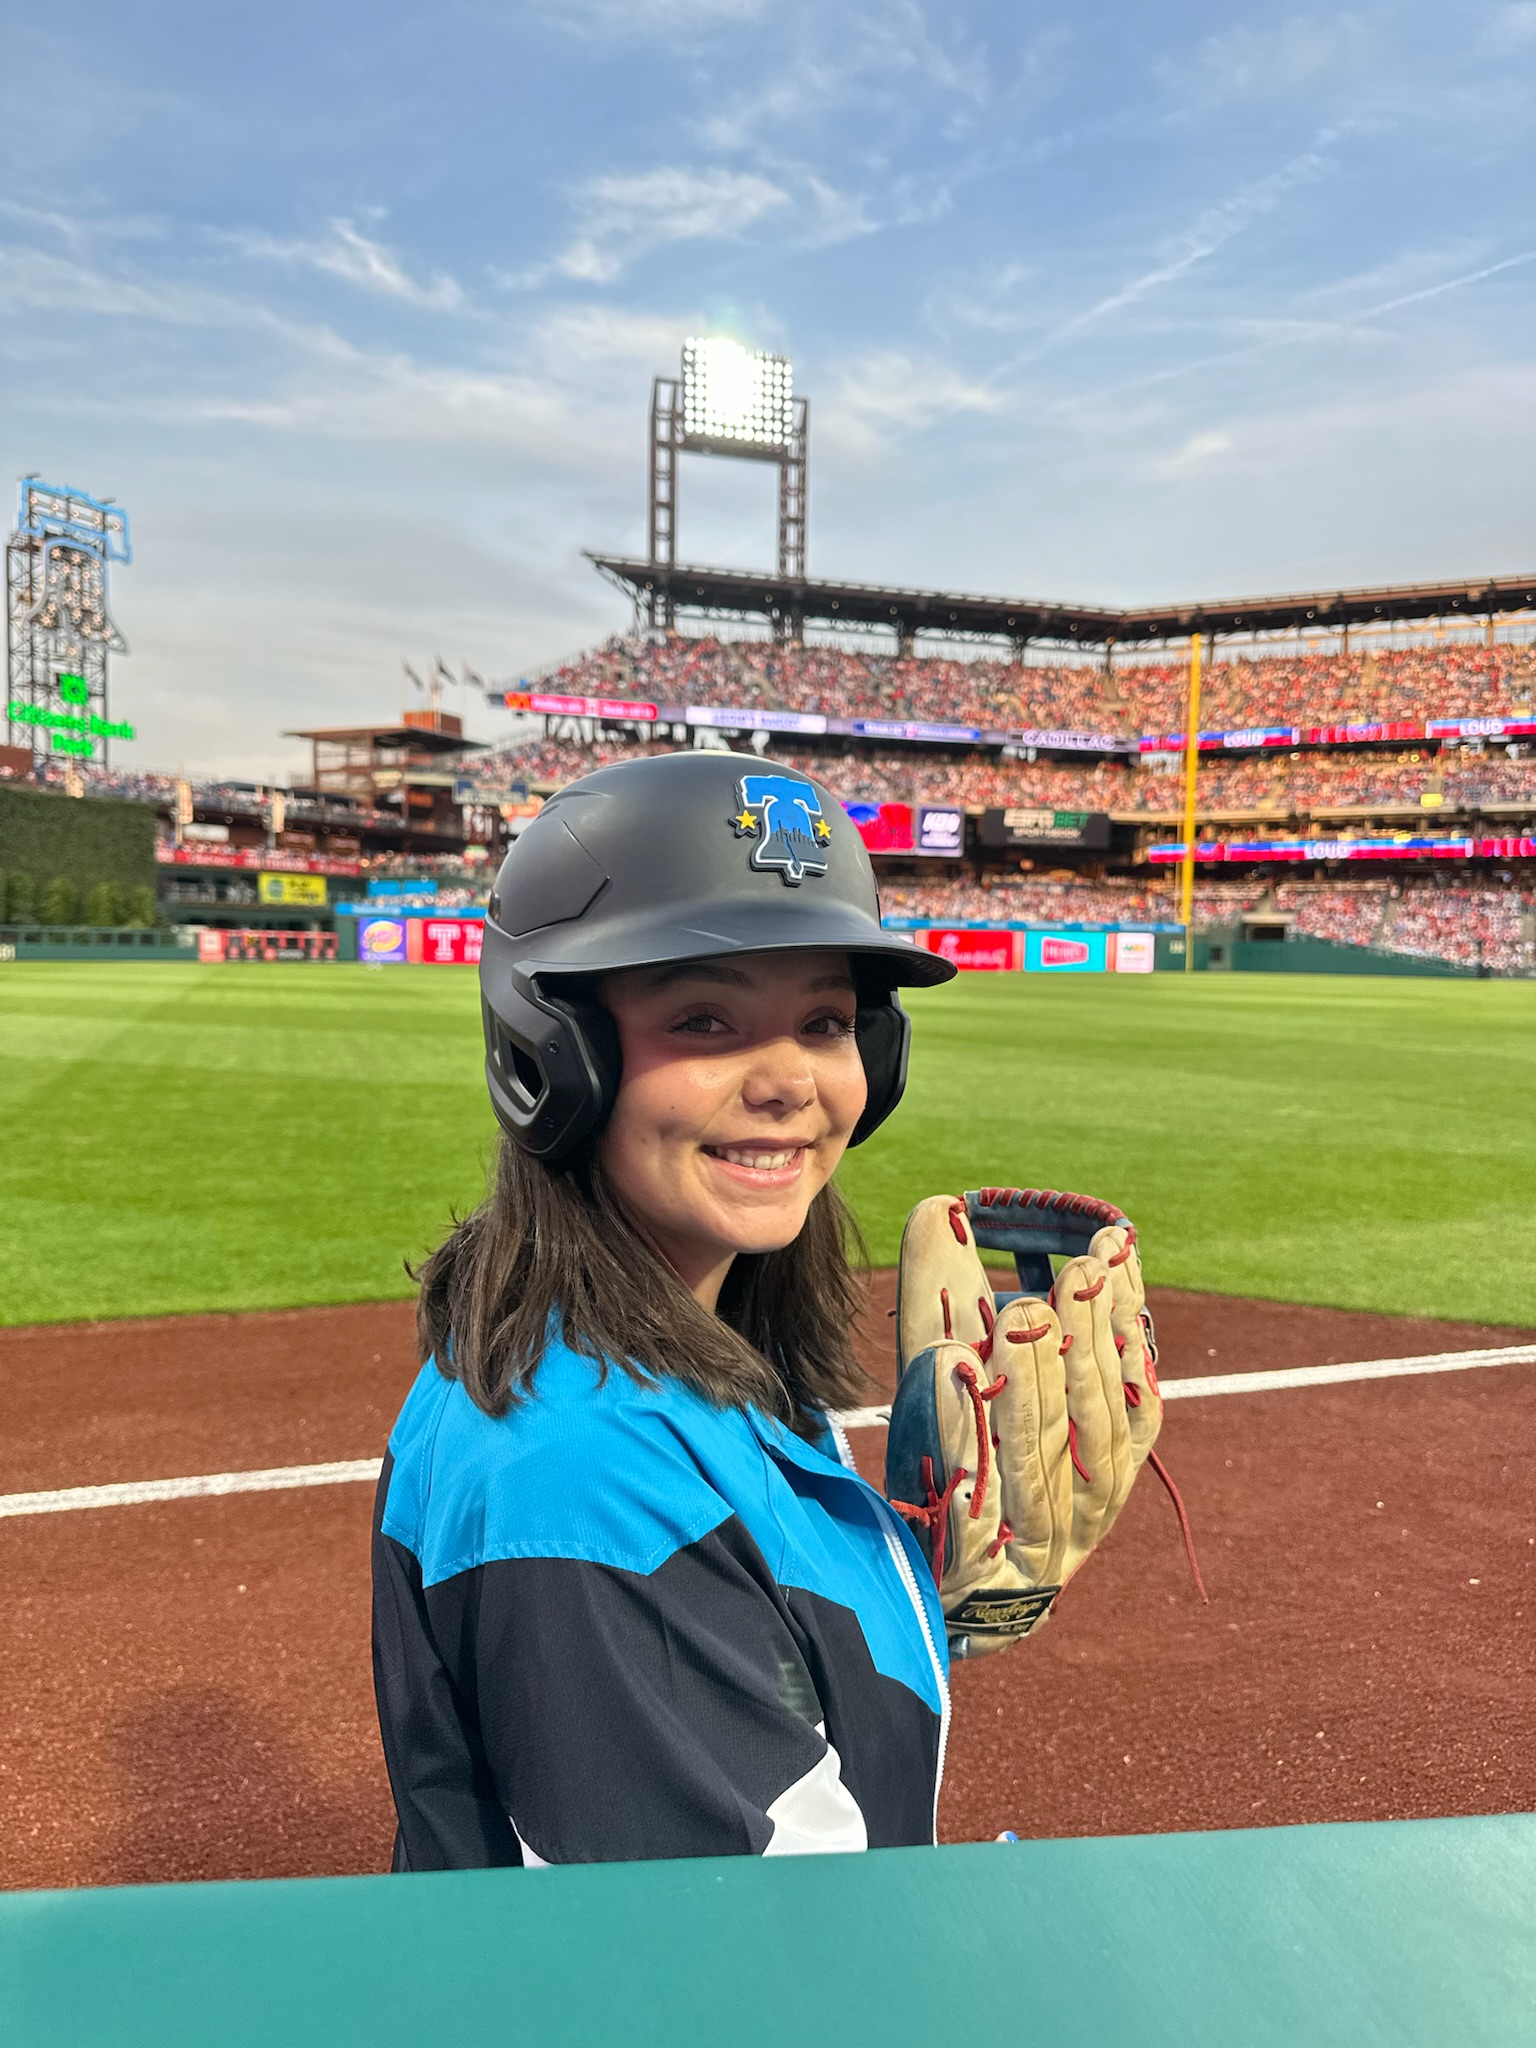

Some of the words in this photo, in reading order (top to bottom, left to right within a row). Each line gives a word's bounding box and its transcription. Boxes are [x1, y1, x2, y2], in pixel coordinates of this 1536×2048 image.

[1459, 718, 1505, 736] LOUD
[52, 733, 94, 758] Park
[1022, 729, 1116, 751] CADILLAC
[1054, 811, 1089, 829] BET
[1304, 841, 1351, 860] LOUD
[961, 1600, 1043, 1620] Rawlings
